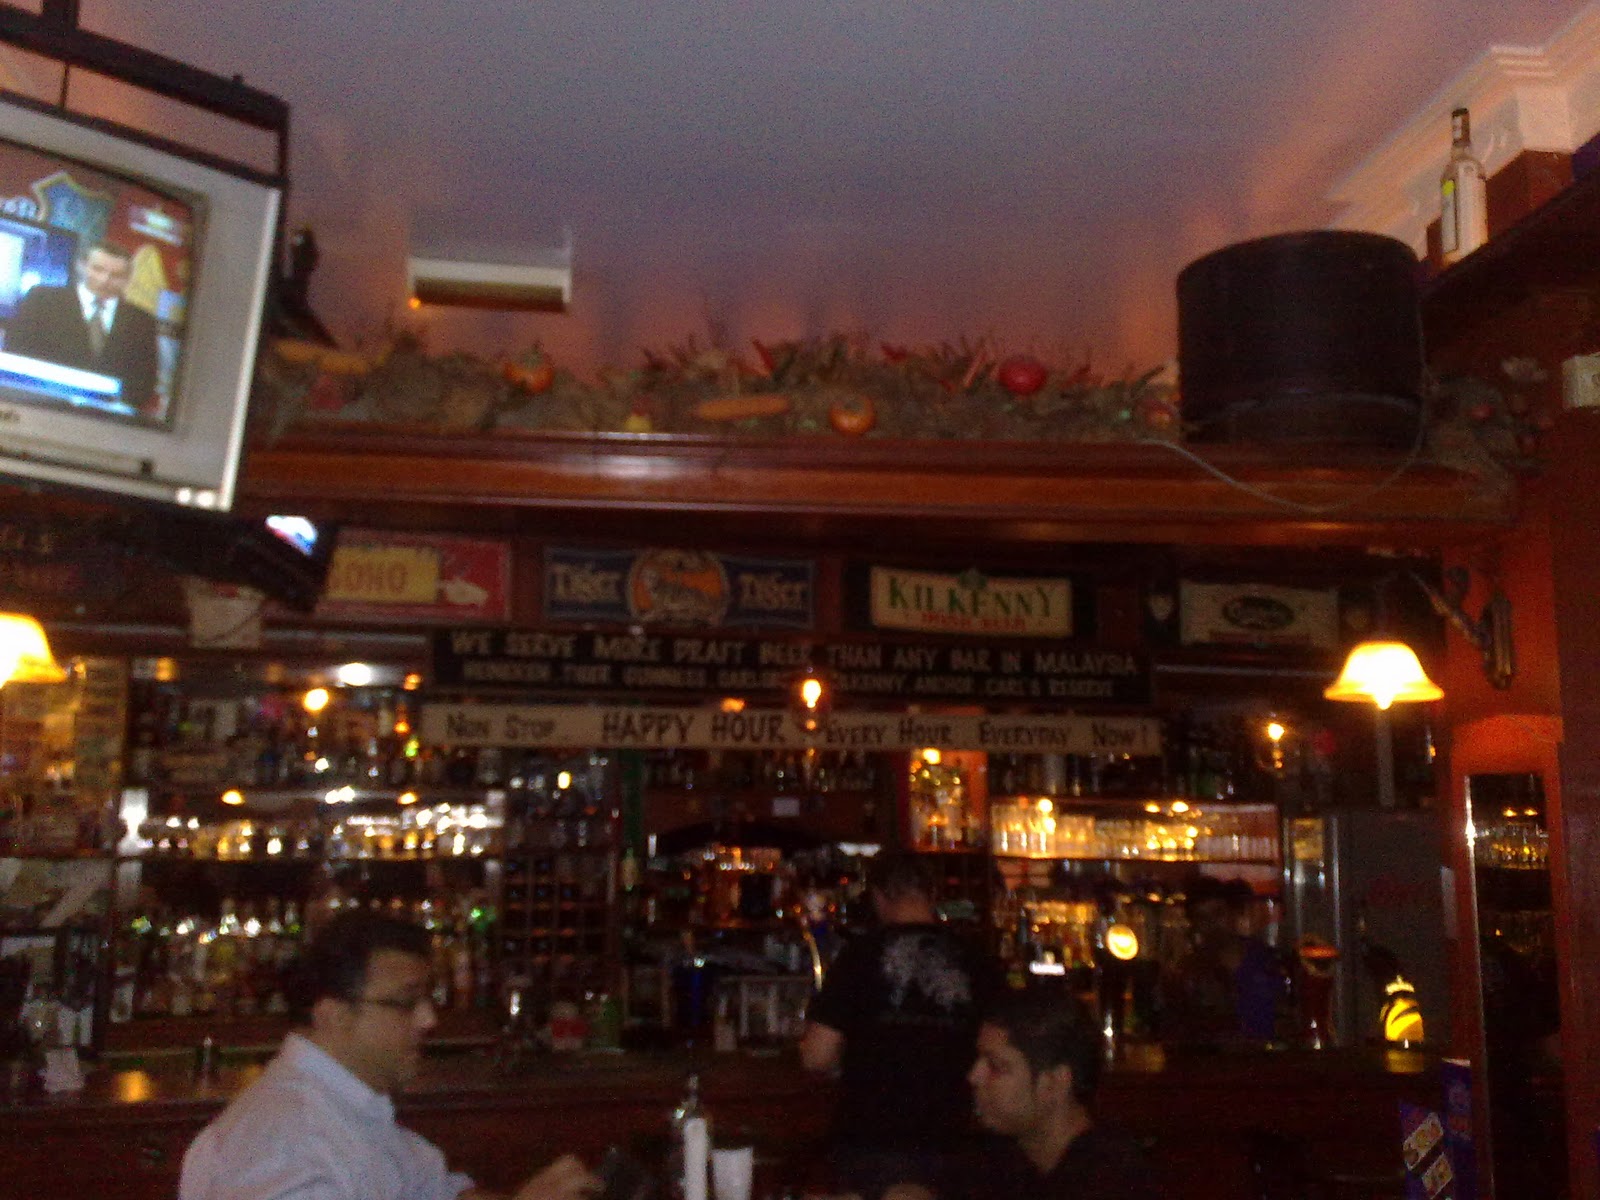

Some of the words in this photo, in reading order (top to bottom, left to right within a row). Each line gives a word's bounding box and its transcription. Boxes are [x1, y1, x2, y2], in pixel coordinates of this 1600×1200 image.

[887, 575, 1057, 618] KILKENNY
[451, 631, 493, 656] WE
[505, 632, 578, 658] SERVE
[593, 635, 664, 662] MORE
[825, 644, 884, 671] THAN
[892, 646, 939, 672] ANY
[949, 648, 993, 675] BAR
[1000, 649, 1023, 674] IN
[1033, 649, 1137, 677] MALAYSIA
[601, 712, 695, 743] HAPPY
[711, 714, 787, 744] HOUR
[978, 720, 1072, 747] EVERYDAY
